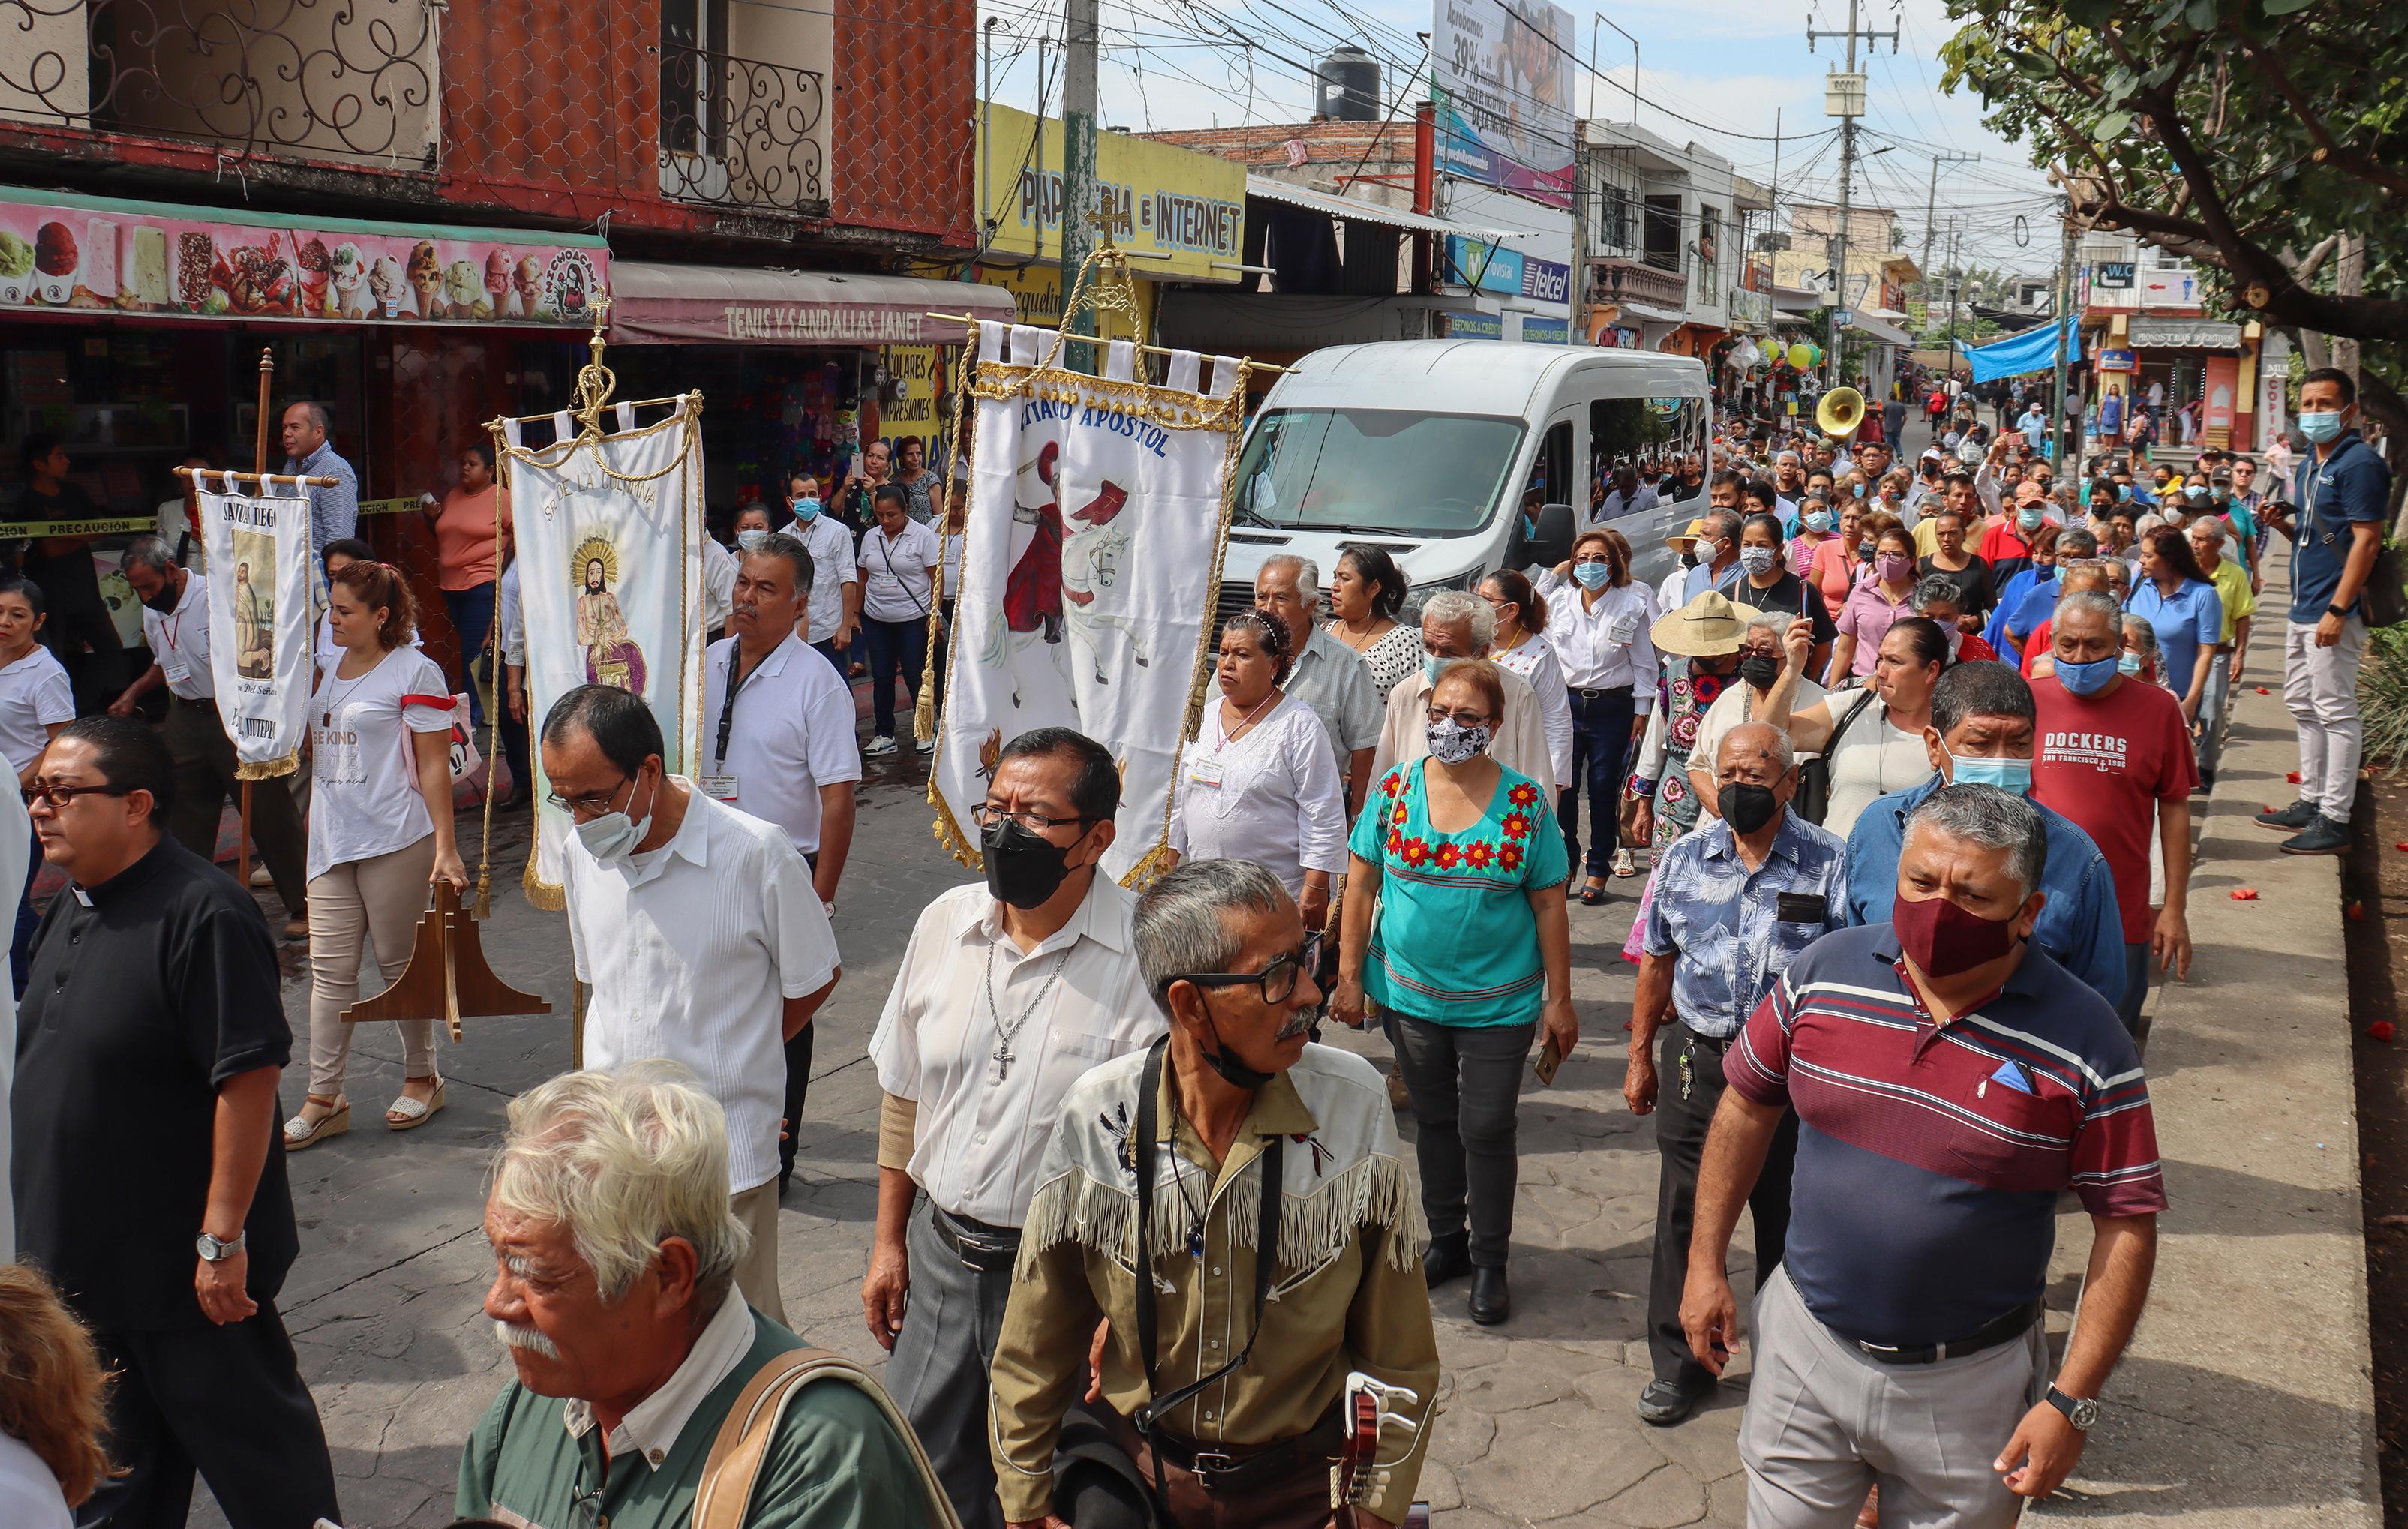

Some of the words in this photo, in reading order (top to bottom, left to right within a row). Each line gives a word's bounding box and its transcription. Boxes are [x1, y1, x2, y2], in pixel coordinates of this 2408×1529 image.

[1447, 0, 1483, 39] Aprobamos
[1452, 33, 1479, 84] 39%
[1142, 198, 1151, 226] E
[1157, 194, 1240, 252] INTERNET
[546, 251, 598, 293] MICHOACANA
[1485, 260, 1513, 280] movistar
[1533, 265, 1567, 301] telcel
[725, 307, 771, 340] TENIS
[774, 308, 785, 338] Y
[788, 308, 875, 340] SANDALIAS
[877, 311, 923, 341] JANET
[2193, 333, 2234, 343] DEPORTIVOS
[1079, 407, 1169, 458] APOSTOL
[557, 479, 573, 501] DE
[577, 472, 595, 492] LA
[50, 521, 130, 534] PRECAUCIÓN
[244, 683, 256, 694] Del
[313, 731, 325, 745] BE
[326, 731, 358, 745] KIND
[2044, 732, 2127, 753] DOCKERS
[2058, 755, 2099, 764] FRANCISCO
[2108, 759, 2126, 768] 1986
